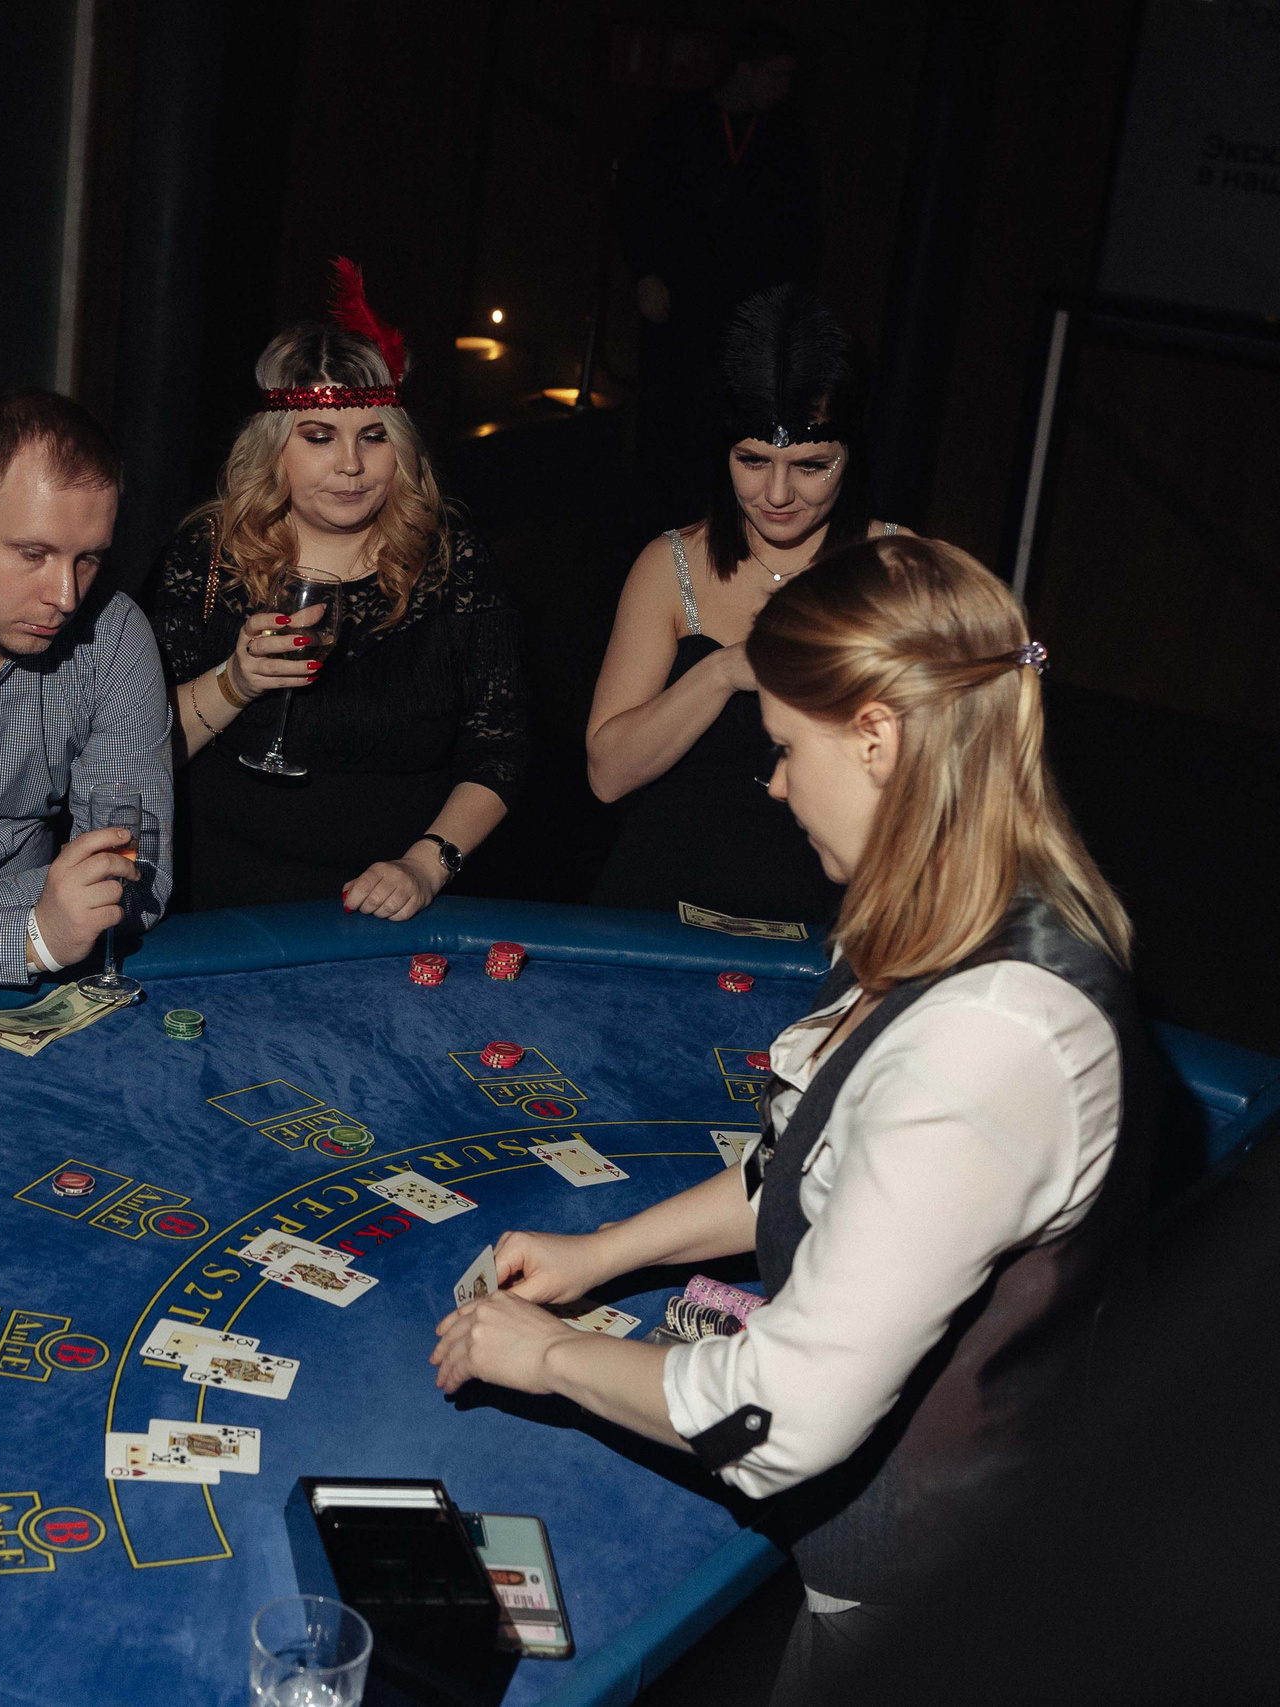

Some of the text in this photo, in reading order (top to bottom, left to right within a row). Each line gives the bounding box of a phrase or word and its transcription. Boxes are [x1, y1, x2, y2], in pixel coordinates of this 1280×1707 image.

[1203, 133, 1280, 165] Экск
[372, 1185, 389, 1195] 10
[455, 1198, 475, 1208] 10
[243, 1250, 263, 1260] K
[331, 1251, 350, 1262] K
[266, 1270, 286, 1279] Q
[354, 1275, 372, 1284] Q
[457, 1284, 467, 1302] Q
[274, 1359, 294, 1369] Q
[189, 1372, 211, 1381] Q
[237, 1429, 256, 1440] K
[152, 1452, 171, 1463] K
